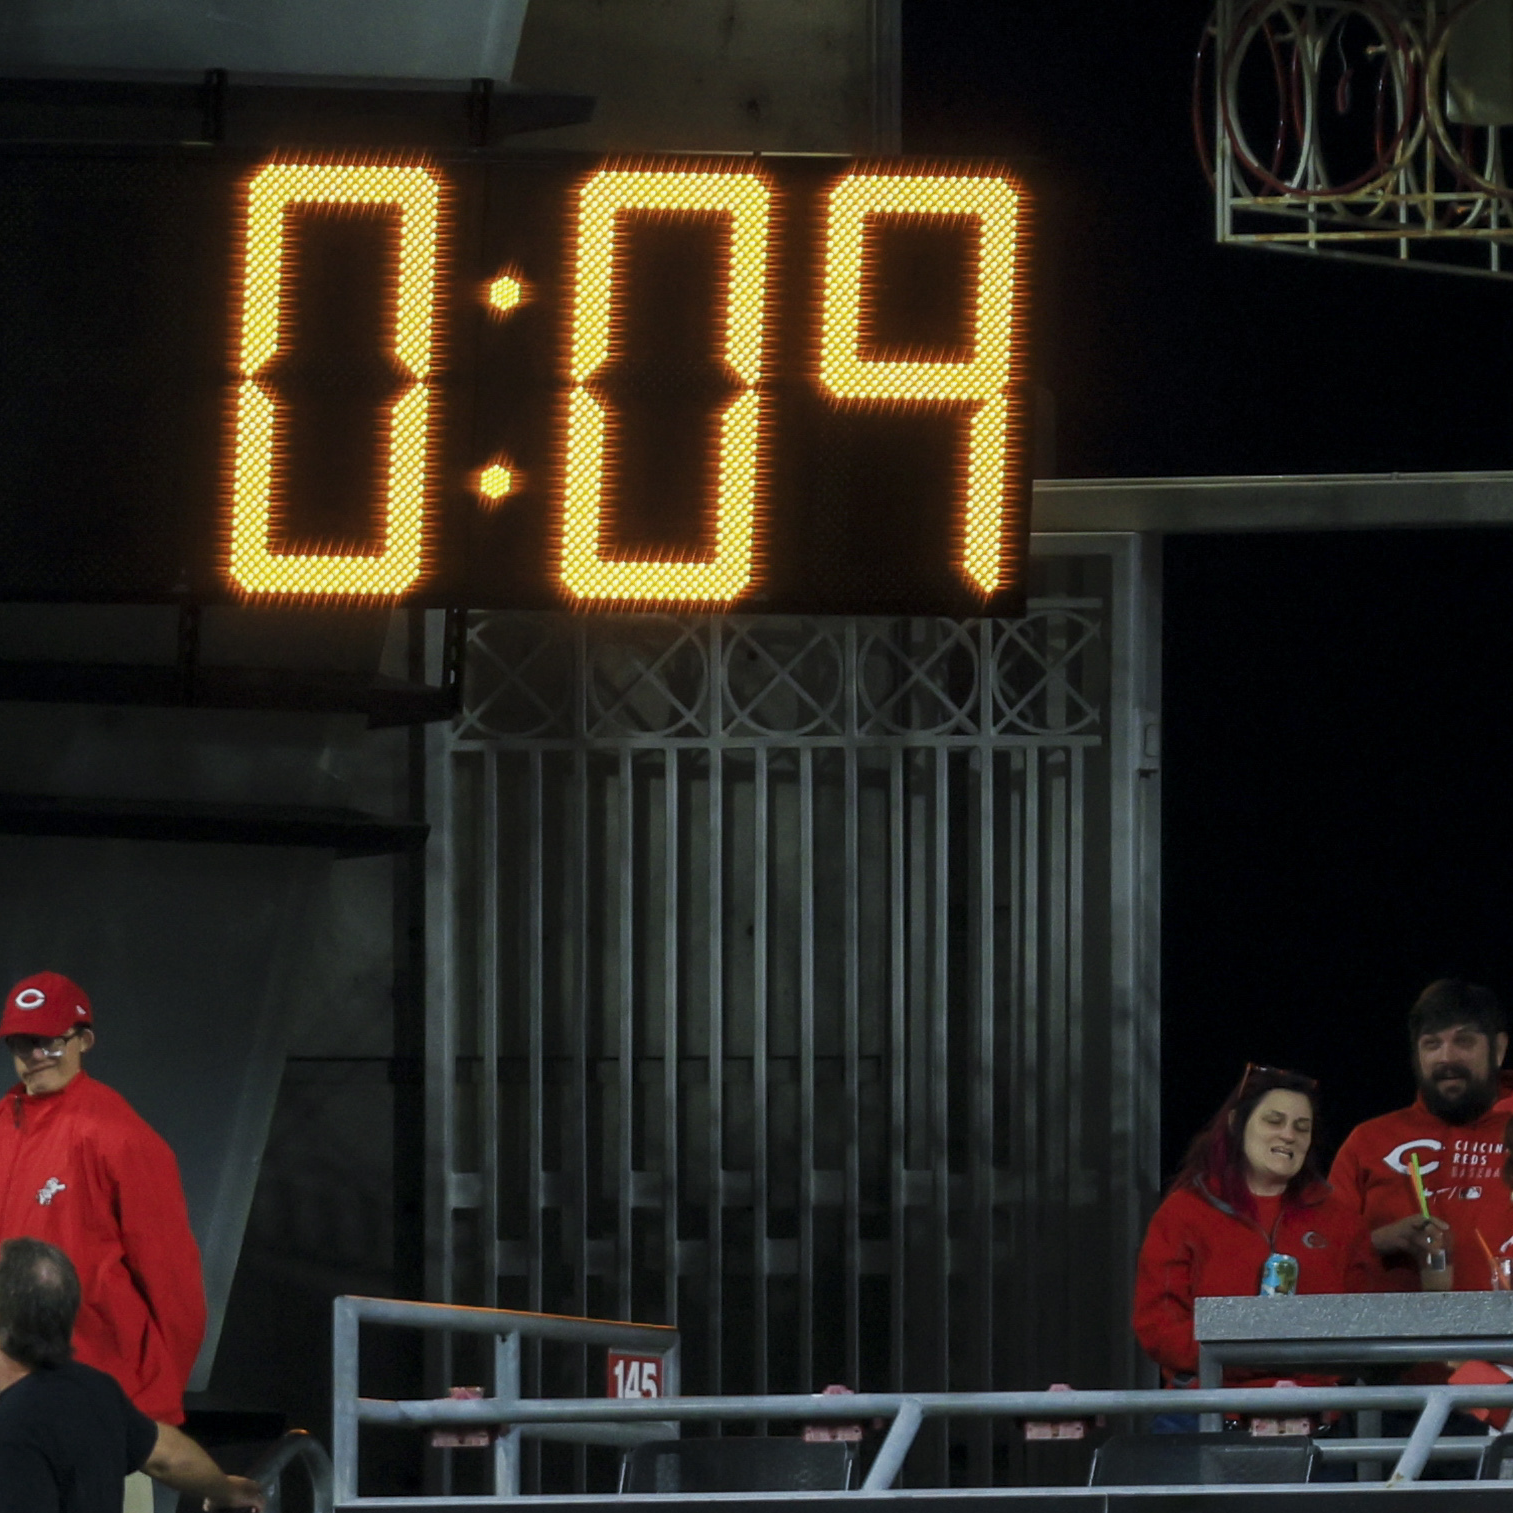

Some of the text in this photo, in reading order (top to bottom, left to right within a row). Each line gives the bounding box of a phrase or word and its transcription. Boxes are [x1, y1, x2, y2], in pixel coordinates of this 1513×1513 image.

[230, 163, 1018, 600] 0:09
[1453, 1153, 1488, 1166] REDS
[614, 1359, 660, 1399] 145
